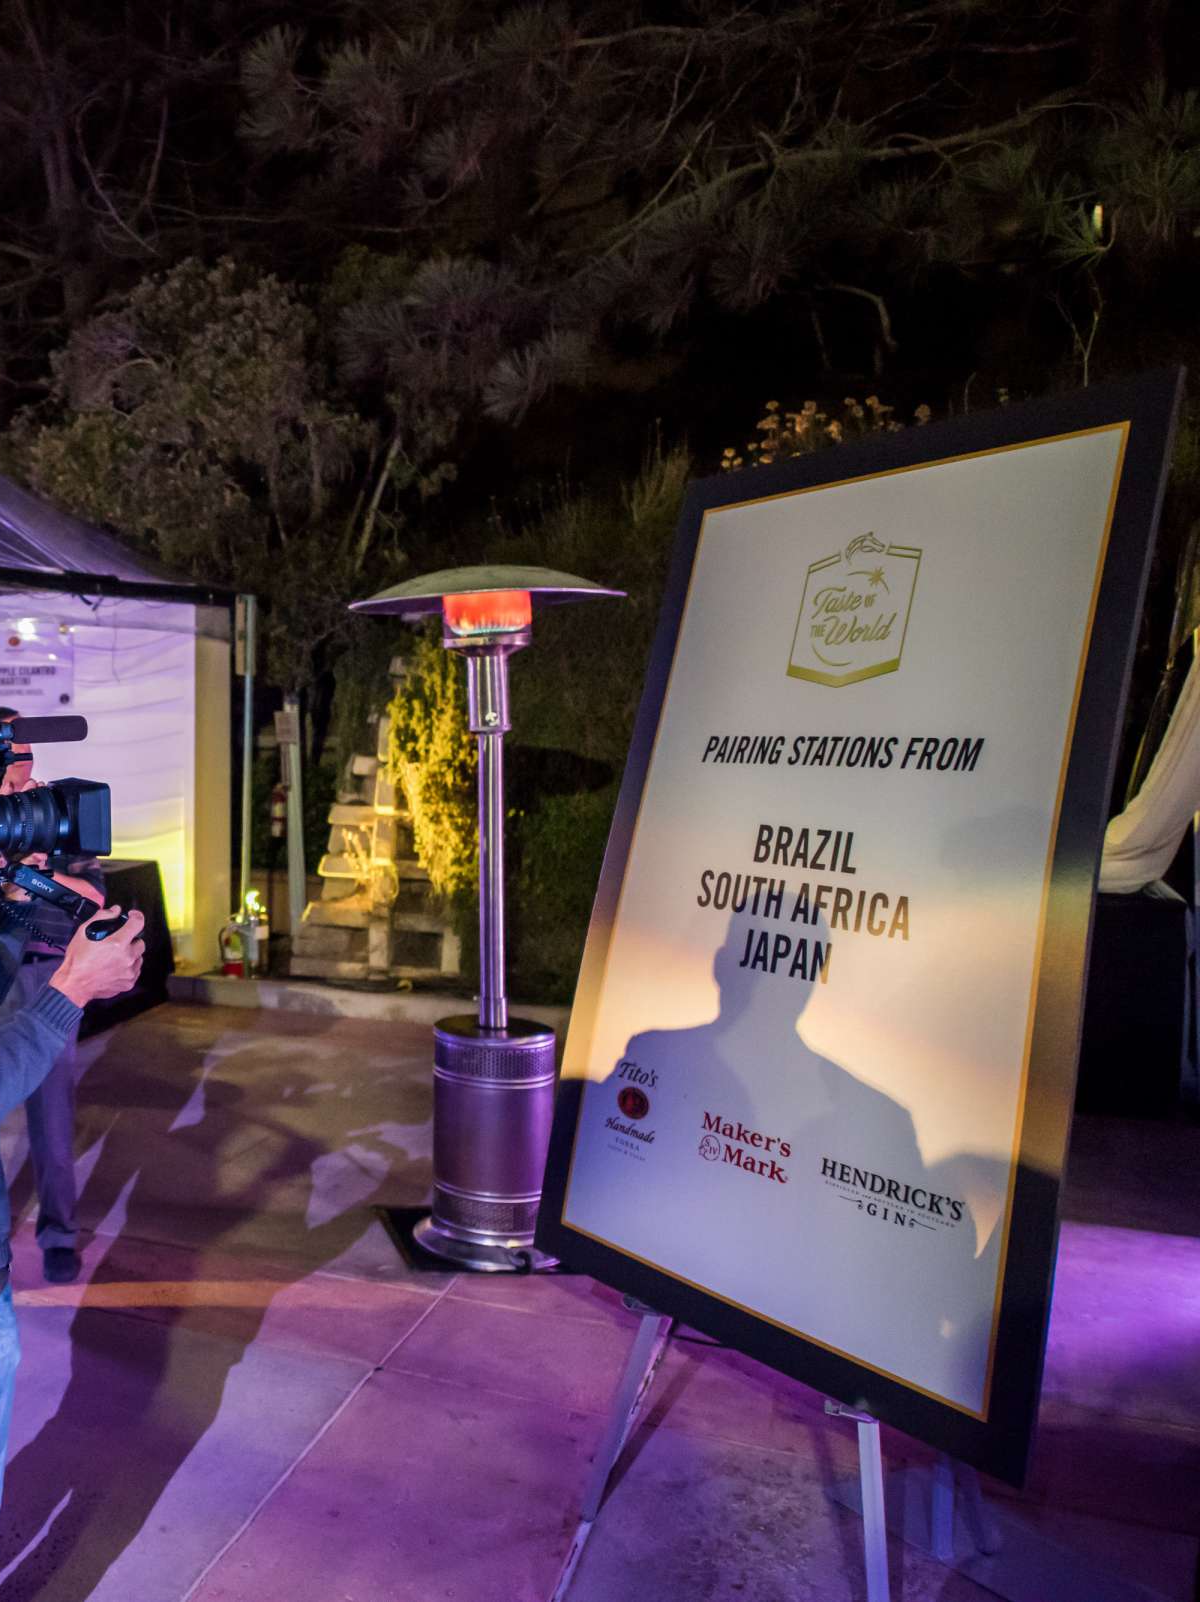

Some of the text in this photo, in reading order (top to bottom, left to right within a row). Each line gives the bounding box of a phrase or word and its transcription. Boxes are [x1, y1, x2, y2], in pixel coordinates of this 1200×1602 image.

[811, 586, 877, 619] Taste OF
[810, 611, 898, 646] THE World
[702, 735, 985, 772] PAIRING STATIONS FROM
[753, 824, 857, 874] BRAZIL
[31, 878, 55, 893] SONY
[697, 869, 911, 941] SOUTH AFRICA
[739, 928, 833, 983] JAPAN
[618, 1062, 659, 1087] Tito's
[605, 1116, 655, 1144] Handmade
[701, 1111, 791, 1158] Maker's
[722, 1144, 786, 1184] Mark
[821, 1157, 963, 1221] HENDRICK'S
[866, 1202, 907, 1227] GIN
